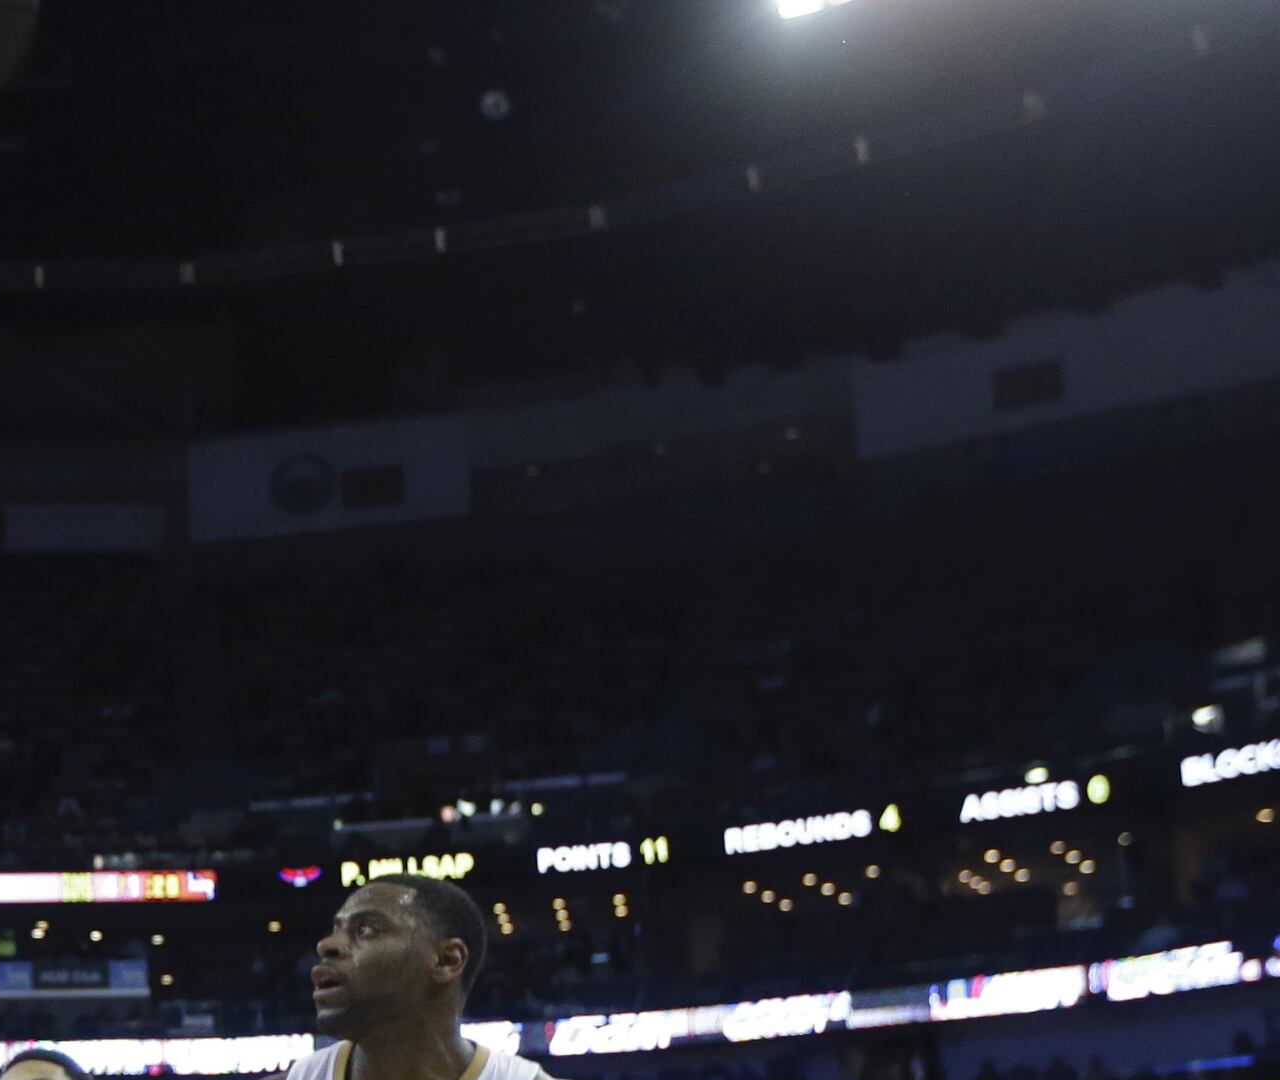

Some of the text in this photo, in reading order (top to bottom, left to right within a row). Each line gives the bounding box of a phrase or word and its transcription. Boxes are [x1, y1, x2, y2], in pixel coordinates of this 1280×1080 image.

[960, 780, 1081, 824] ASSISTS
[724, 803, 901, 855] REBOUNDS 4
[536, 836, 669, 874] POINTS 11
